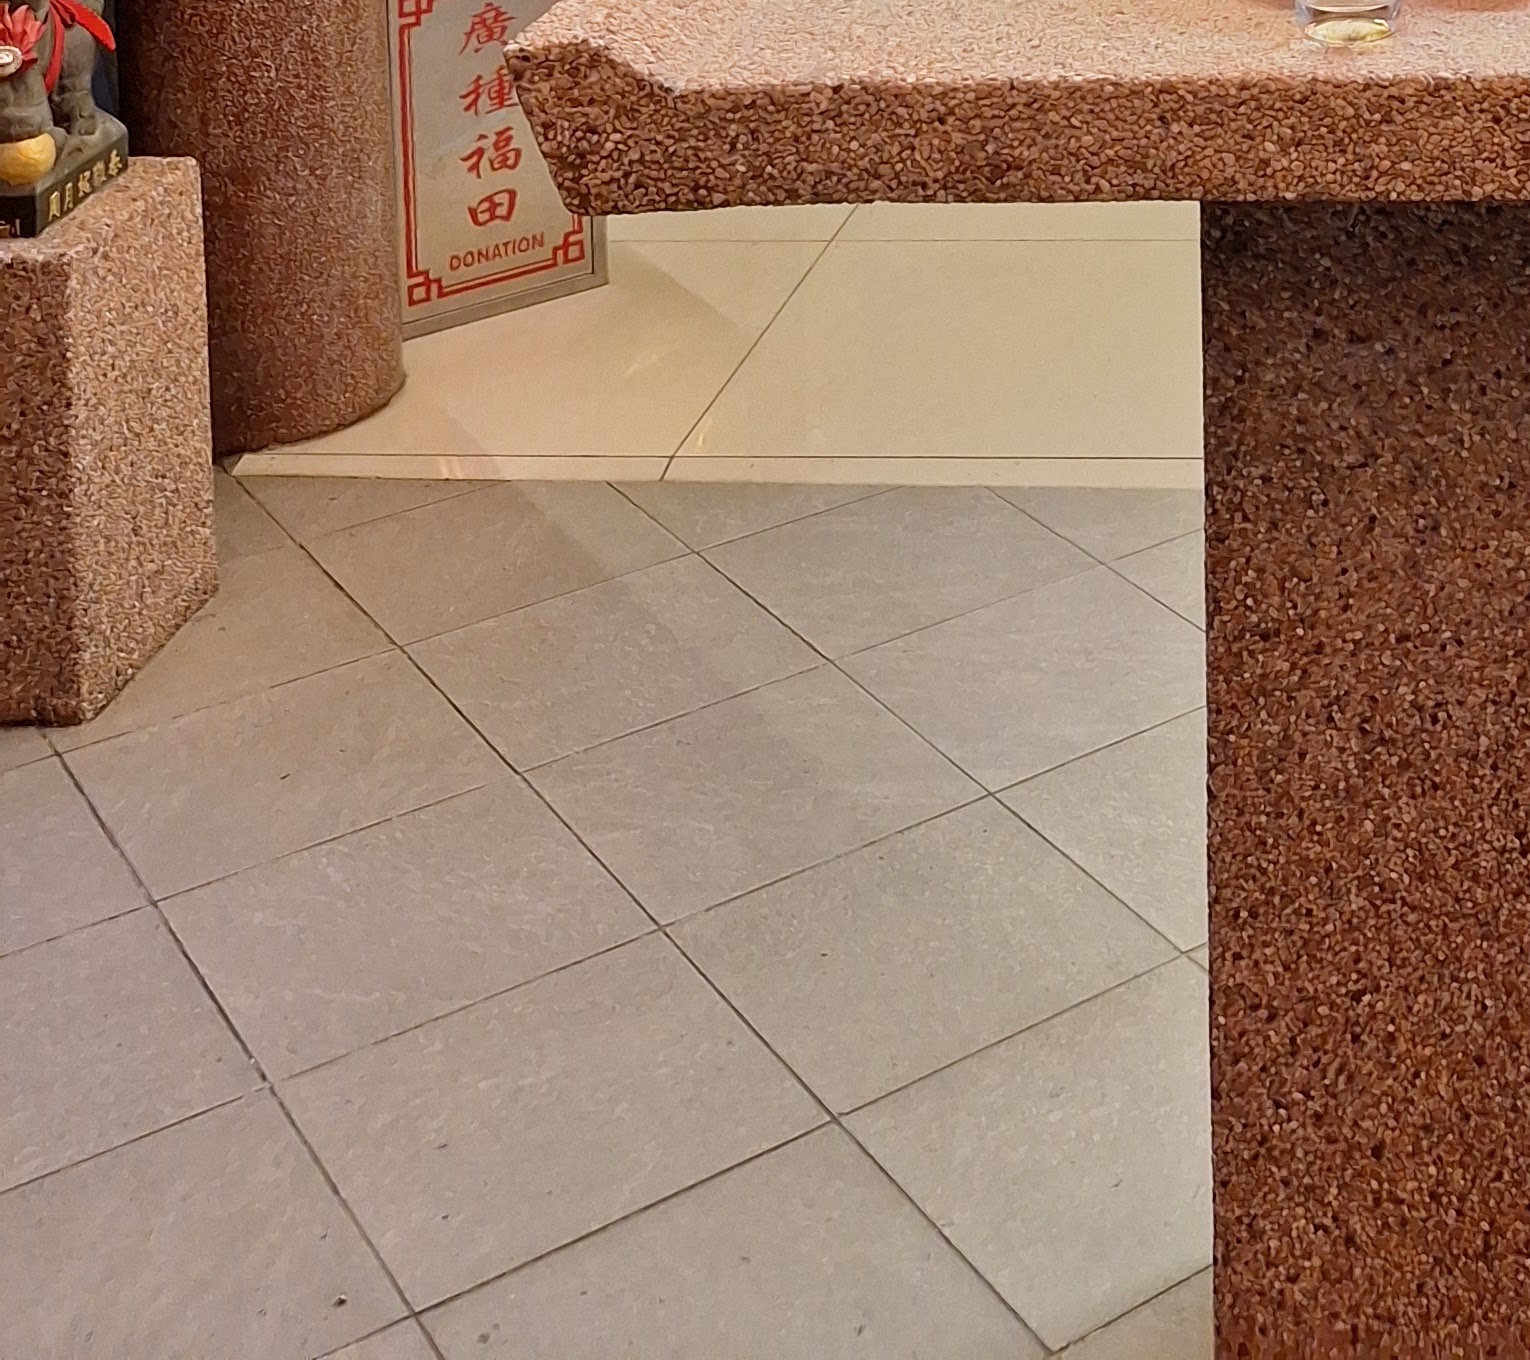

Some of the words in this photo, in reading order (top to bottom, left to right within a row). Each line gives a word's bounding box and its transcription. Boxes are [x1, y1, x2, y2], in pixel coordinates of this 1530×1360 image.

[457, 0, 523, 229] 廣種福田
[449, 231, 546, 272] DONATION
